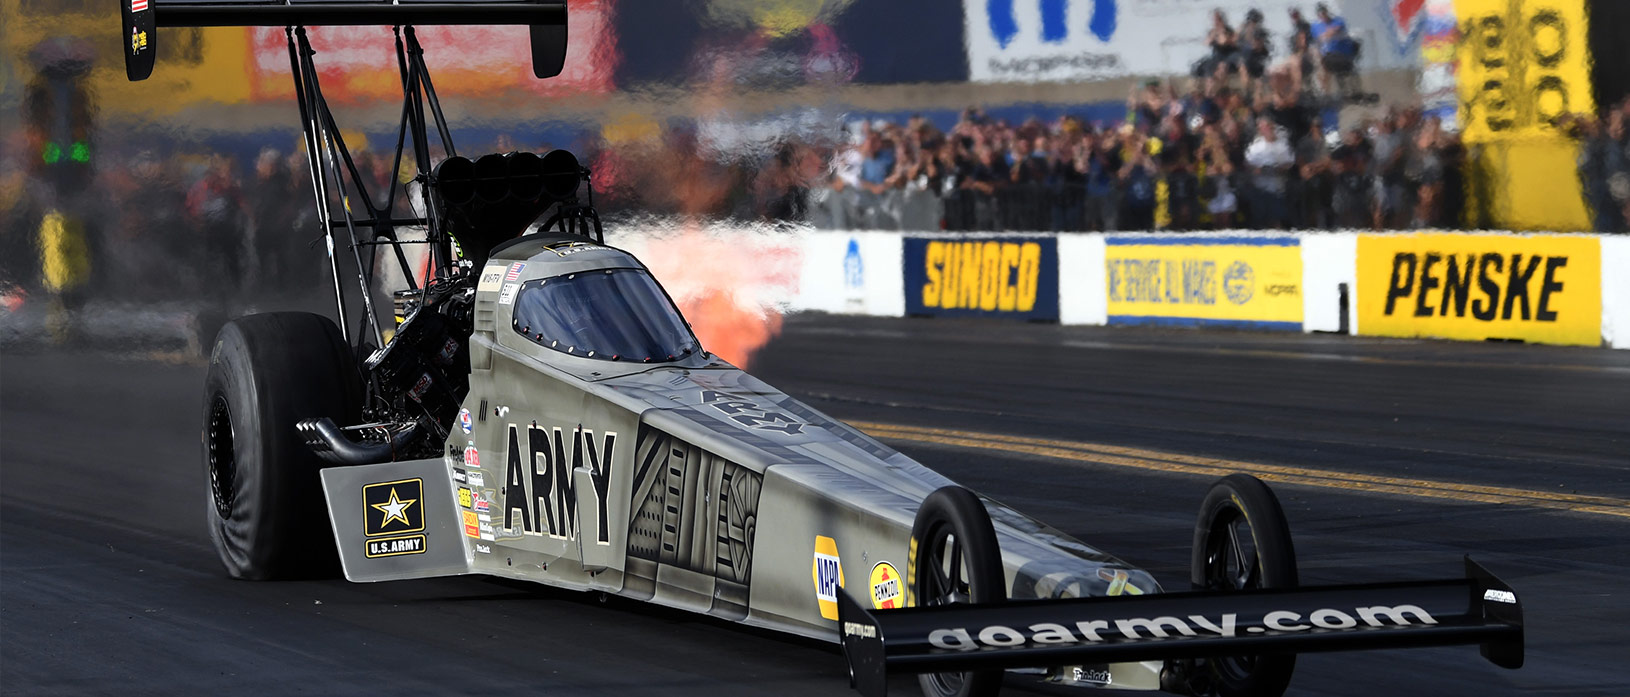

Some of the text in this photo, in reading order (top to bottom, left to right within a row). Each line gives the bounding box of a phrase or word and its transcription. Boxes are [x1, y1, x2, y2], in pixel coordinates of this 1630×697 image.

[923, 241, 1041, 312] SUNOCO
[1384, 251, 1569, 323] PENSKE
[699, 389, 807, 437] ARMY
[503, 423, 618, 546] ARMY
[817, 557, 840, 599] NAPA
[874, 579, 899, 602] PENNZOIL
[844, 621, 877, 640] goarmy.com
[928, 604, 1438, 651] goarmy.com
